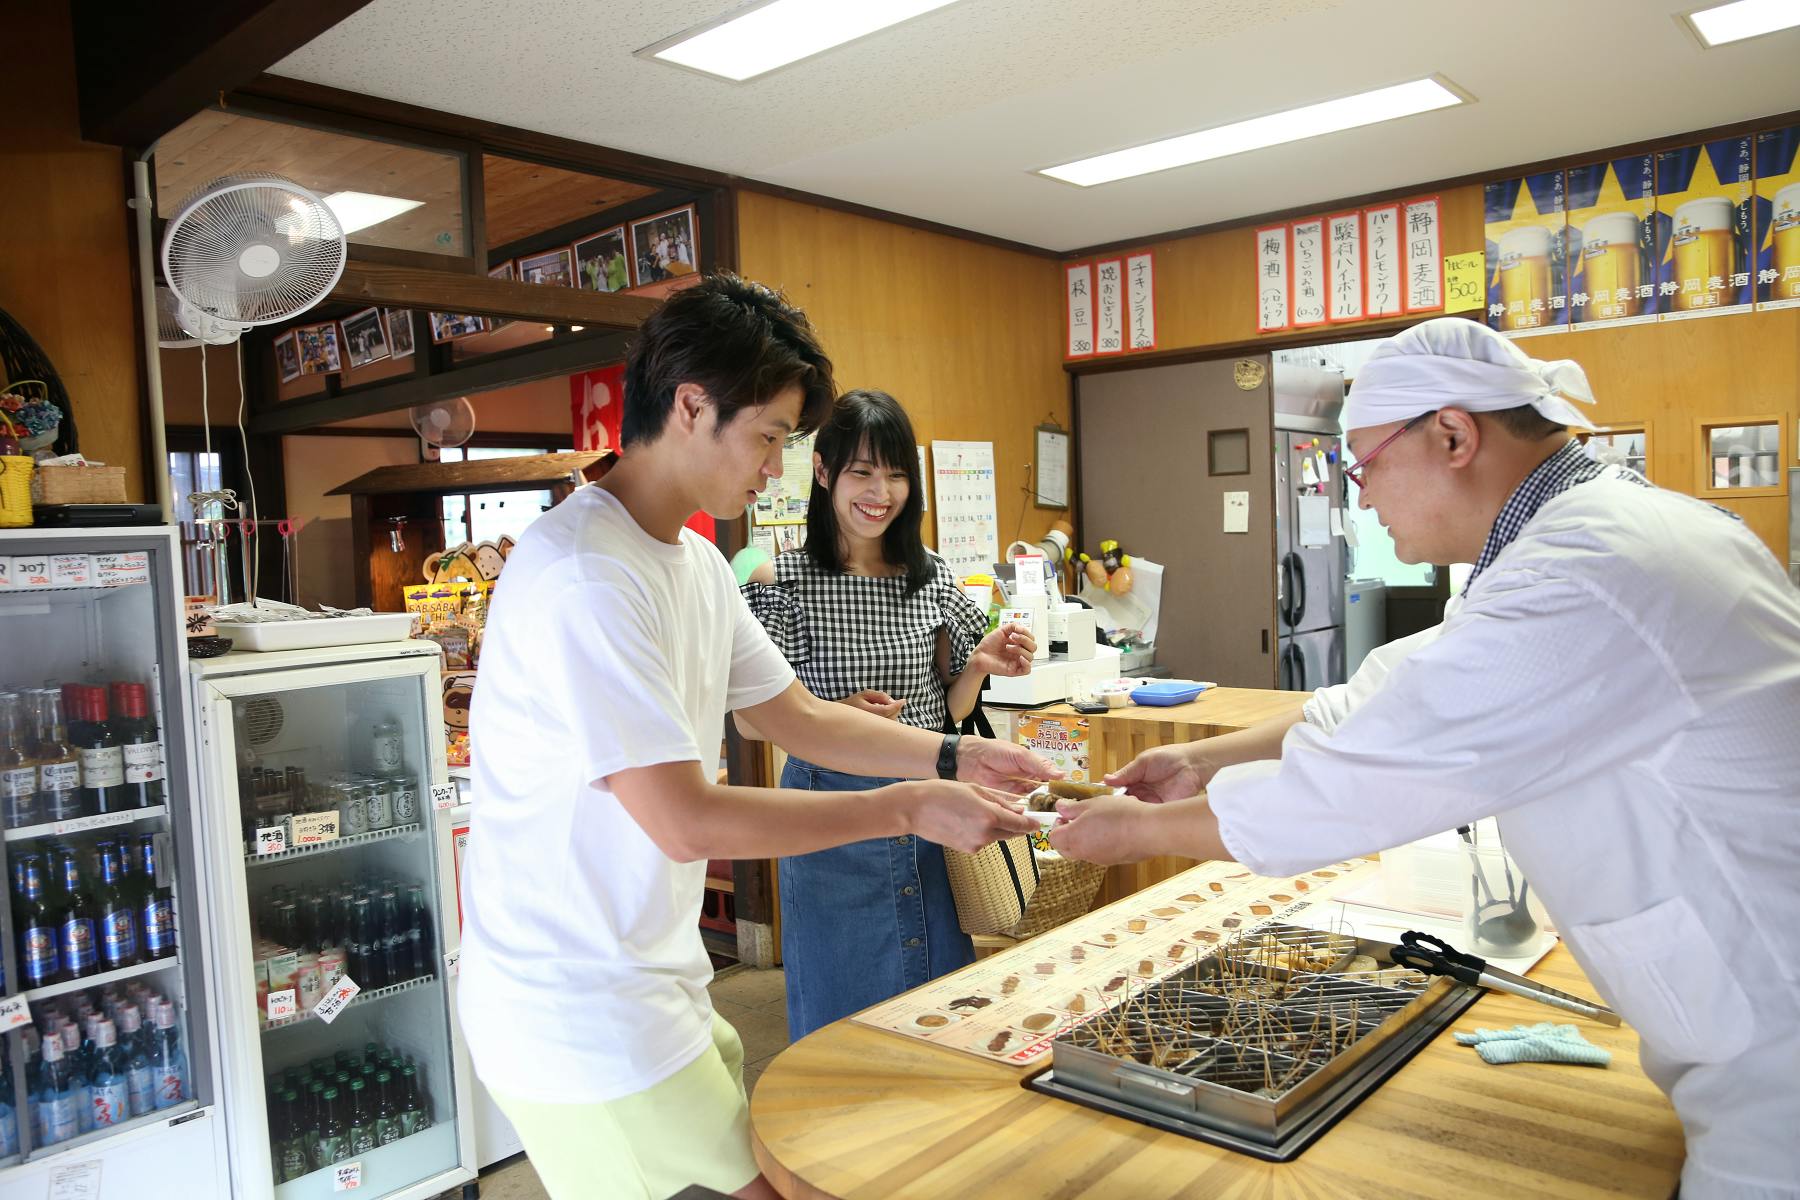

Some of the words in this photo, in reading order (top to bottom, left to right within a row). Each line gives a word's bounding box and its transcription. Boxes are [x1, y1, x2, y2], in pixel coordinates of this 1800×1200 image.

[1263, 238, 1280, 278] 梅酒
[1409, 213, 1436, 306] 静岡麦酒
[1450, 281, 1477, 300] 500
[1571, 284, 1655, 307] 静岡麦酒
[1659, 272, 1750, 297] 静岡麦酒
[1071, 279, 1087, 326] 枝豆
[1132, 261, 1149, 339] チキンライス
[1489, 296, 1566, 317] 静岡麦酒
[431, 603, 456, 612] SABA
[1037, 730, 1068, 741] みらい飯
[260, 829, 284, 843] 地酒
